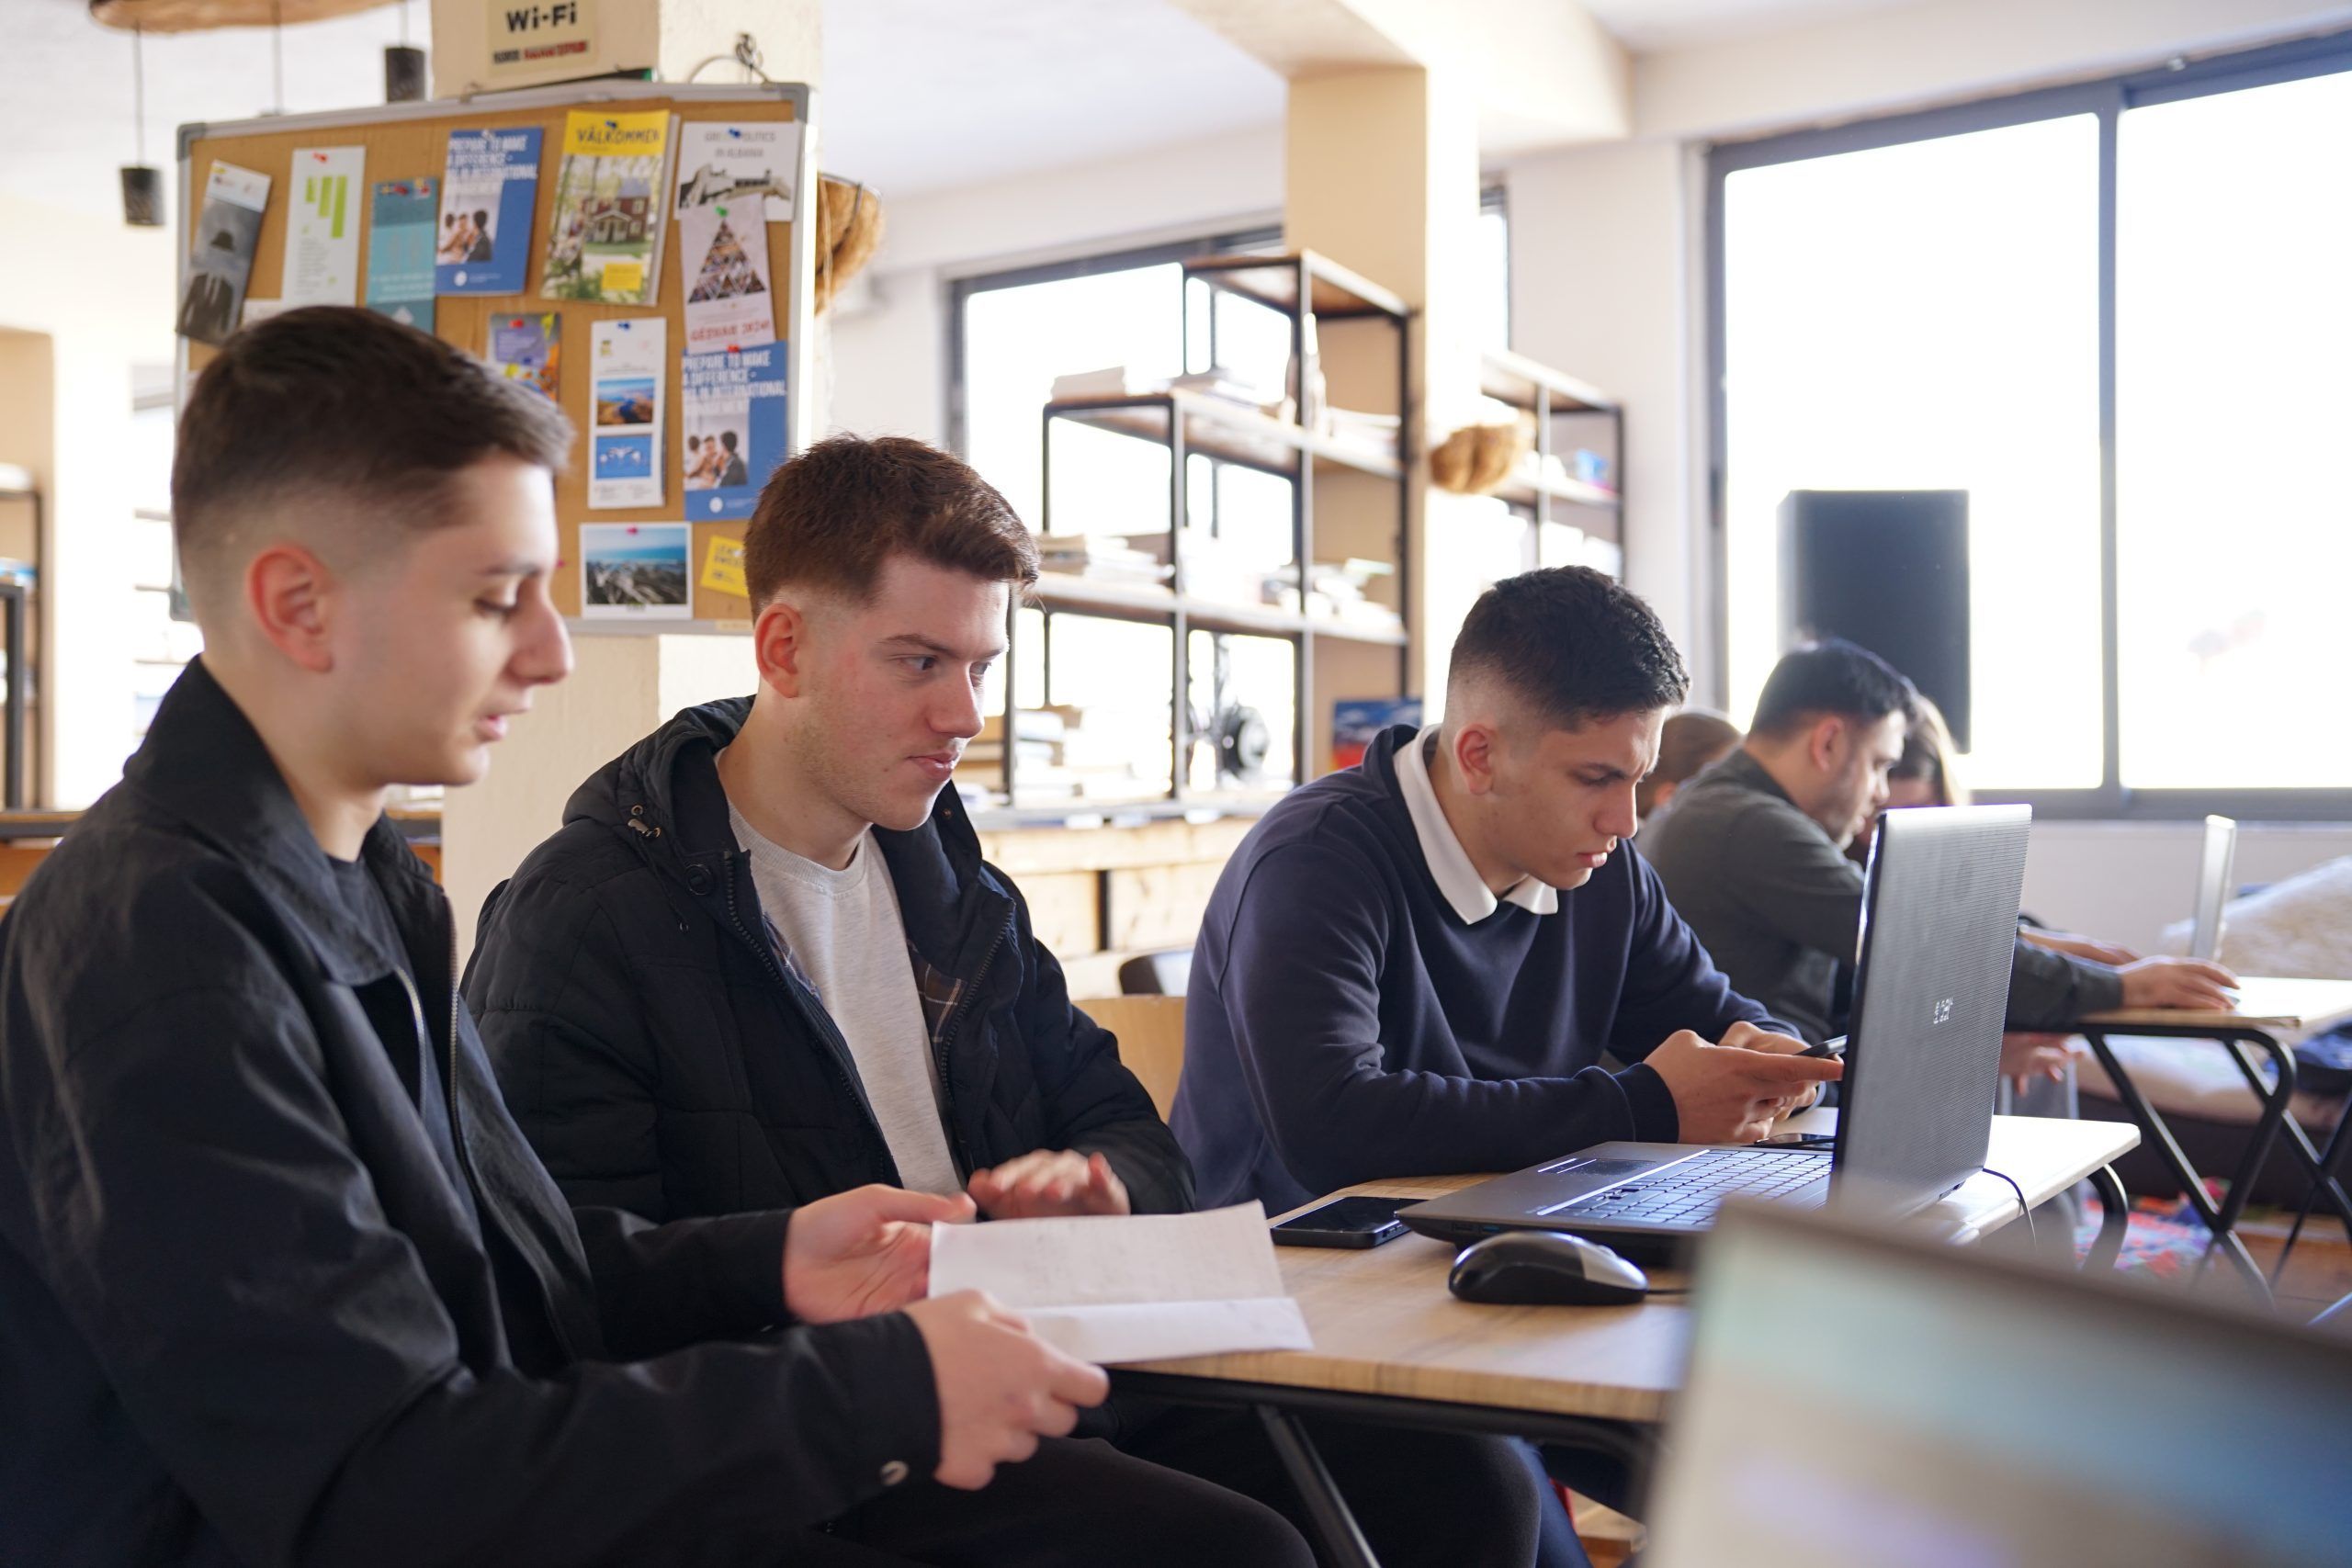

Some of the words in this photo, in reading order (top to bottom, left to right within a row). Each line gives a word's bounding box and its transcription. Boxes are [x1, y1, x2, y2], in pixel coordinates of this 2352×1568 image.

[506, 1, 576, 32] Wi-Fi
[683, 354, 724, 371] PREPARE
[727, 352, 741, 368] TO
[742, 349, 771, 367] MAKE
[690, 368, 749, 387] DIFFERENCE
